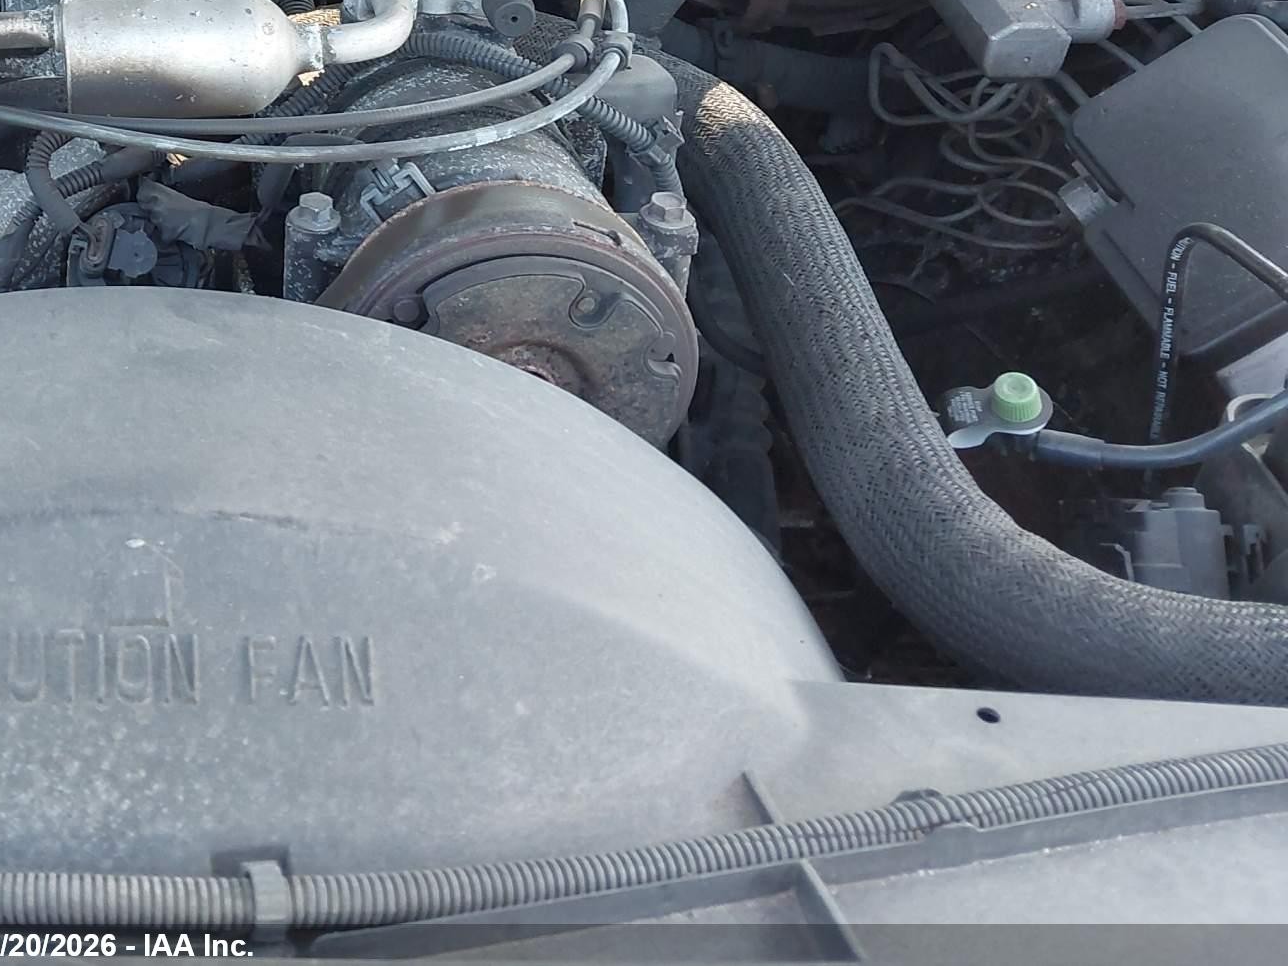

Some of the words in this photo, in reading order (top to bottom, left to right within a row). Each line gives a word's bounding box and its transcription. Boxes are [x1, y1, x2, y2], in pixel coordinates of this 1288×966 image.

[1166, 272, 1178, 294] FUEL
[1160, 307, 1175, 359] FLAMMABLE
[243, 634, 376, 709] FAN
